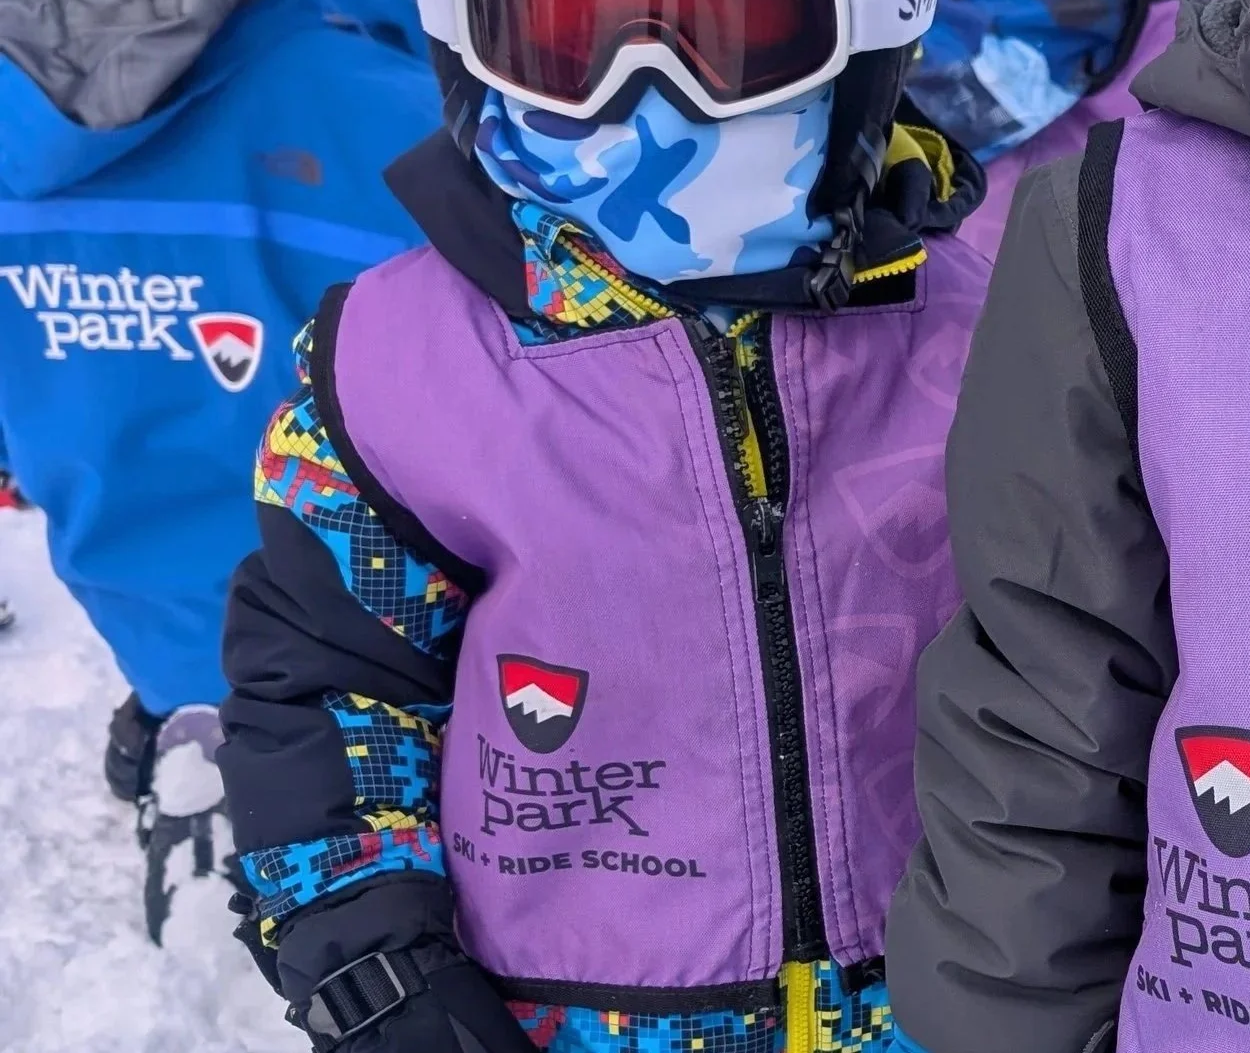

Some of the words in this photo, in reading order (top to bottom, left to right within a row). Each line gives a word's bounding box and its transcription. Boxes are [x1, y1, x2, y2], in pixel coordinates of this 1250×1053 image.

[0, 263, 204, 311] Winter
[477, 733, 667, 796] Winter
[453, 832, 475, 863] SKI
[499, 852, 573, 875] RIDE
[582, 850, 707, 877] SCHOOL
[1136, 964, 1171, 1003] SKI
